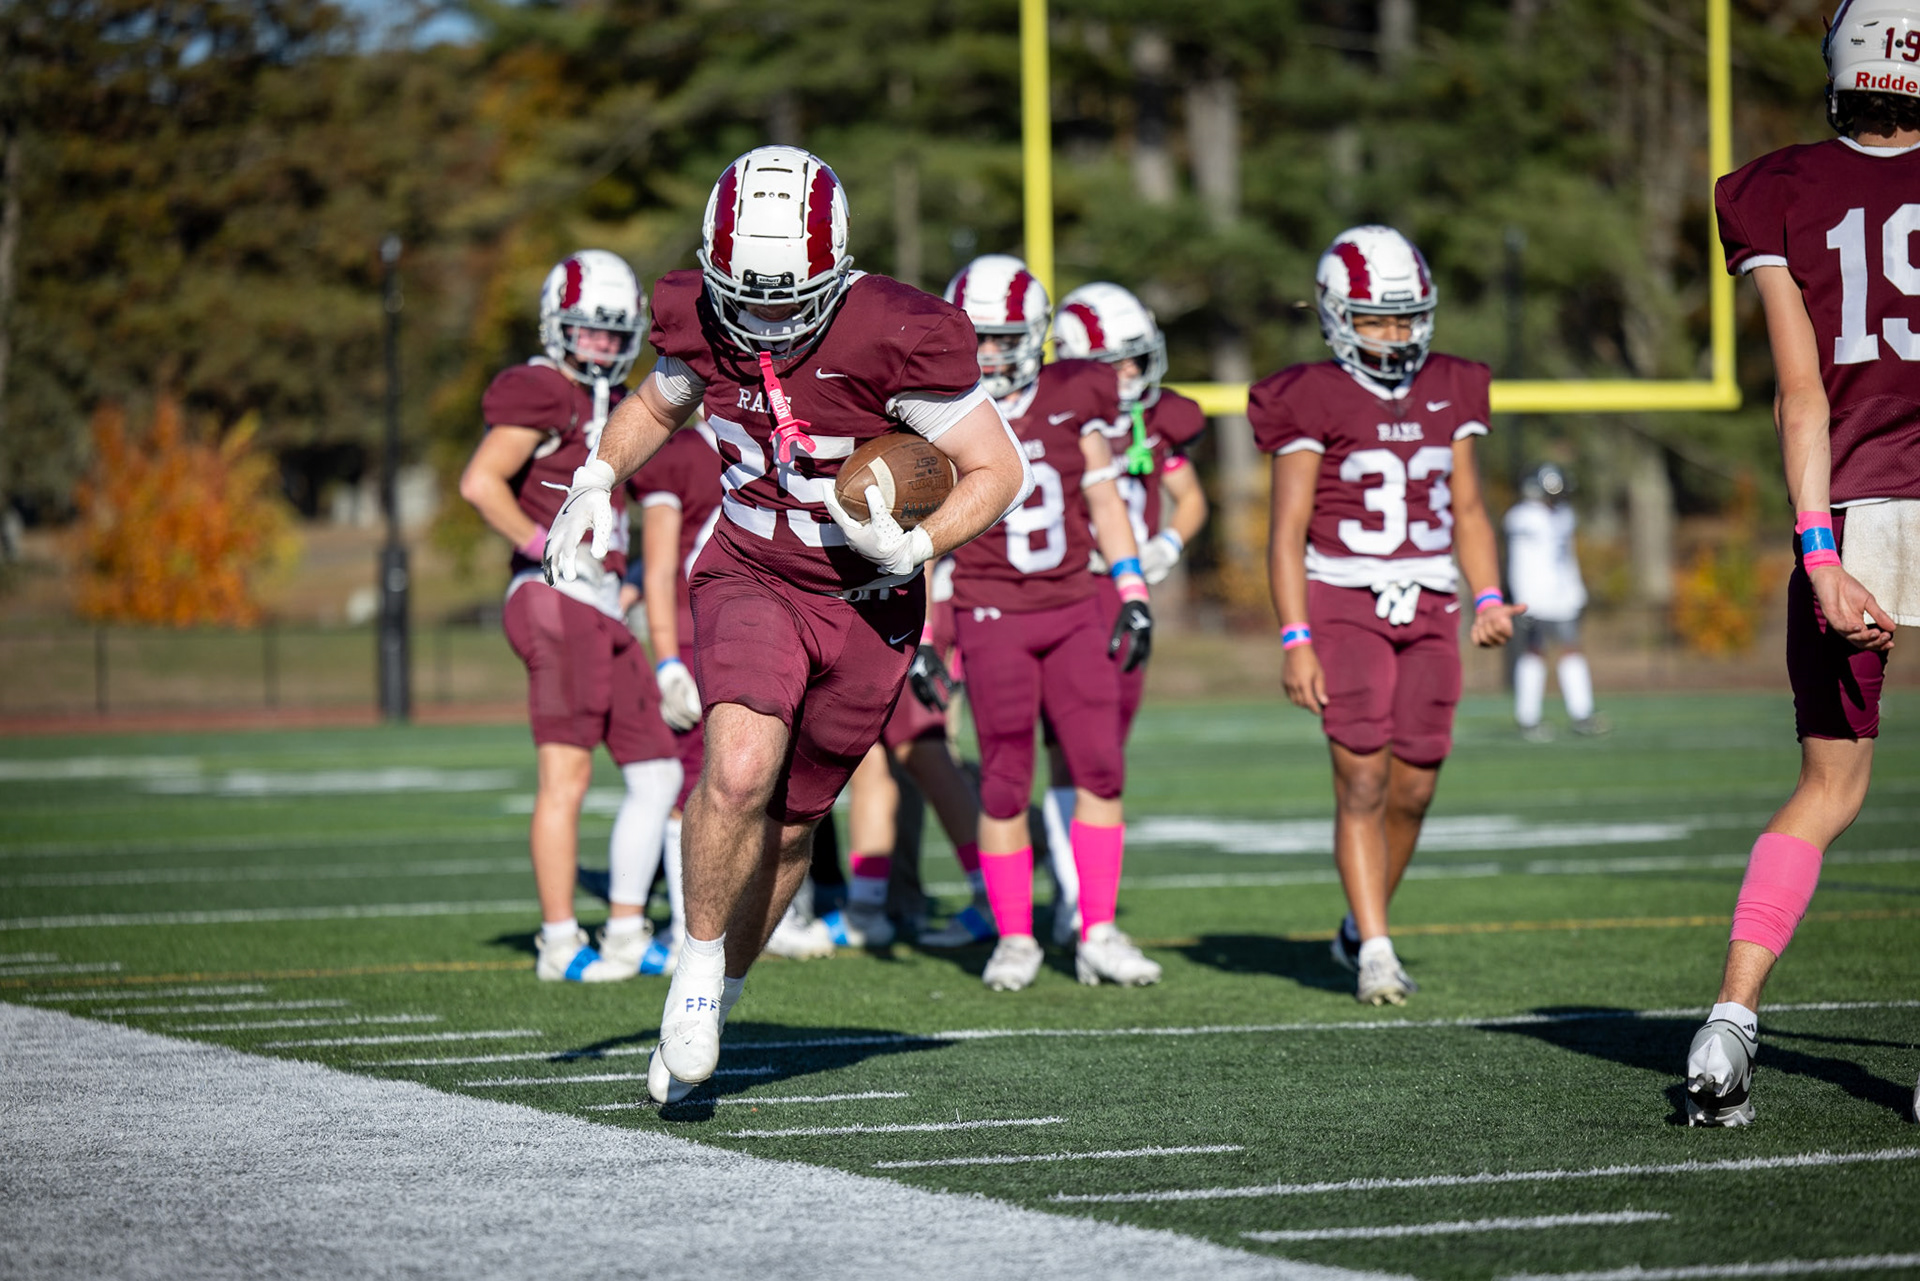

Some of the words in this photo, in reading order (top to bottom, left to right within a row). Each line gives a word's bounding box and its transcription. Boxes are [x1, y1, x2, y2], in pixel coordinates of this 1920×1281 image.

[1855, 71, 1920, 95] Ridde
[1884, 26, 1920, 62] 19
[1826, 203, 1920, 364] 19
[707, 413, 856, 548] 25
[1005, 461, 1068, 575] 8
[1338, 445, 1454, 556] 33
